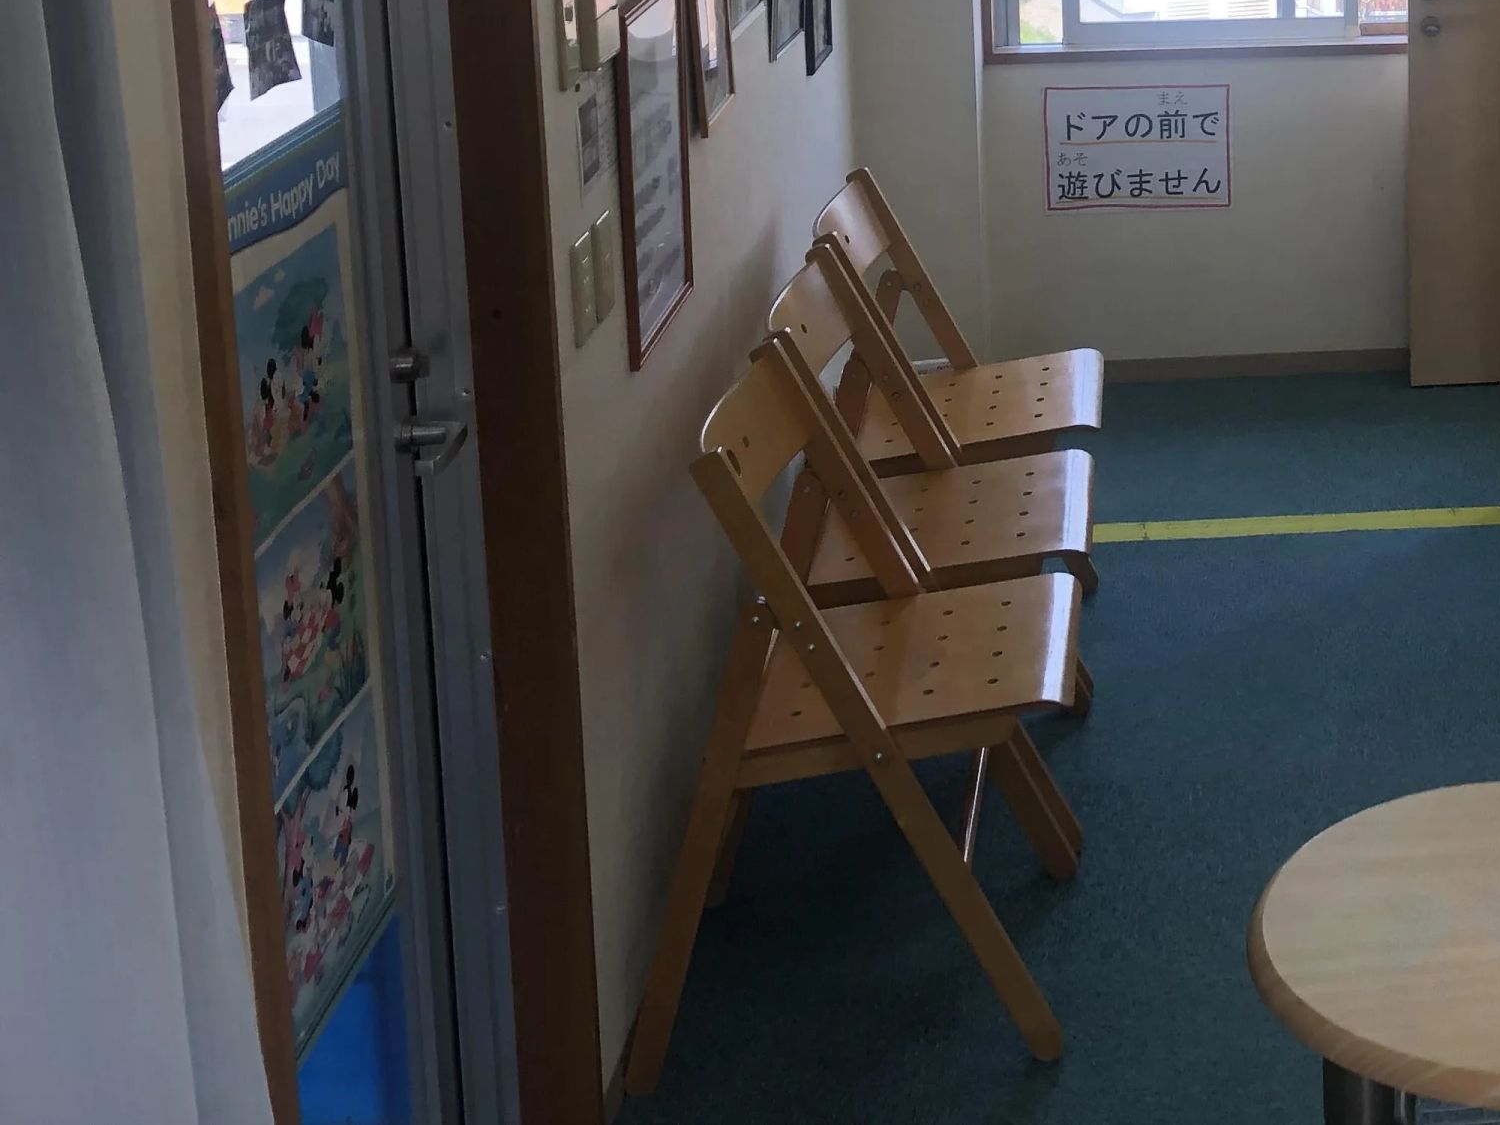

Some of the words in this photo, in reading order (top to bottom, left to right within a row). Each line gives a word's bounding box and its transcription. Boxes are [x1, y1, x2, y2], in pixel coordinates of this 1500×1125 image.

[1157, 91, 1189, 105] まえ
[1066, 109, 1220, 140] ドアの前で
[1057, 152, 1088, 166] あそ
[270, 175, 313, 222] Happy
[315, 151, 340, 189] Day
[1058, 167, 1221, 200] 遊びません
